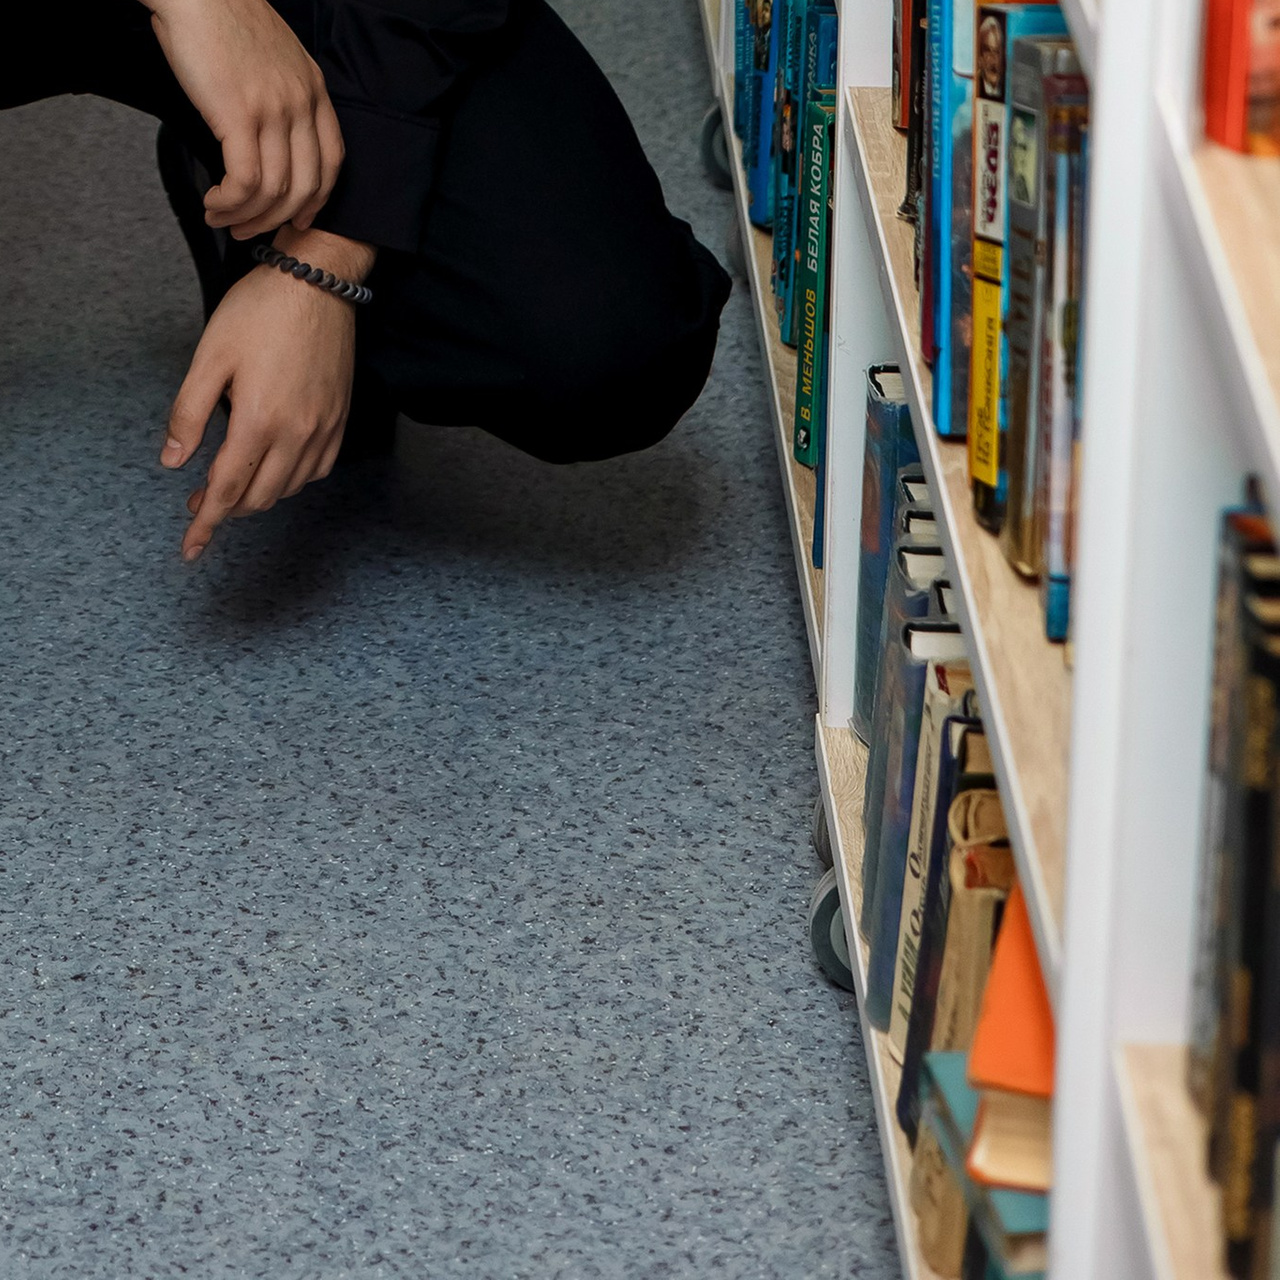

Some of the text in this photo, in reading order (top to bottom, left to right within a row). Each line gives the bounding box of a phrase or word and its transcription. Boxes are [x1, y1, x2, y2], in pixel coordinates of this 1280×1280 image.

[932, 43, 940, 179] ПОСЛЕДНИЙ
[800, 123, 824, 422] В. МЕНЬШОВ БЕЛАЯ КОБРА
